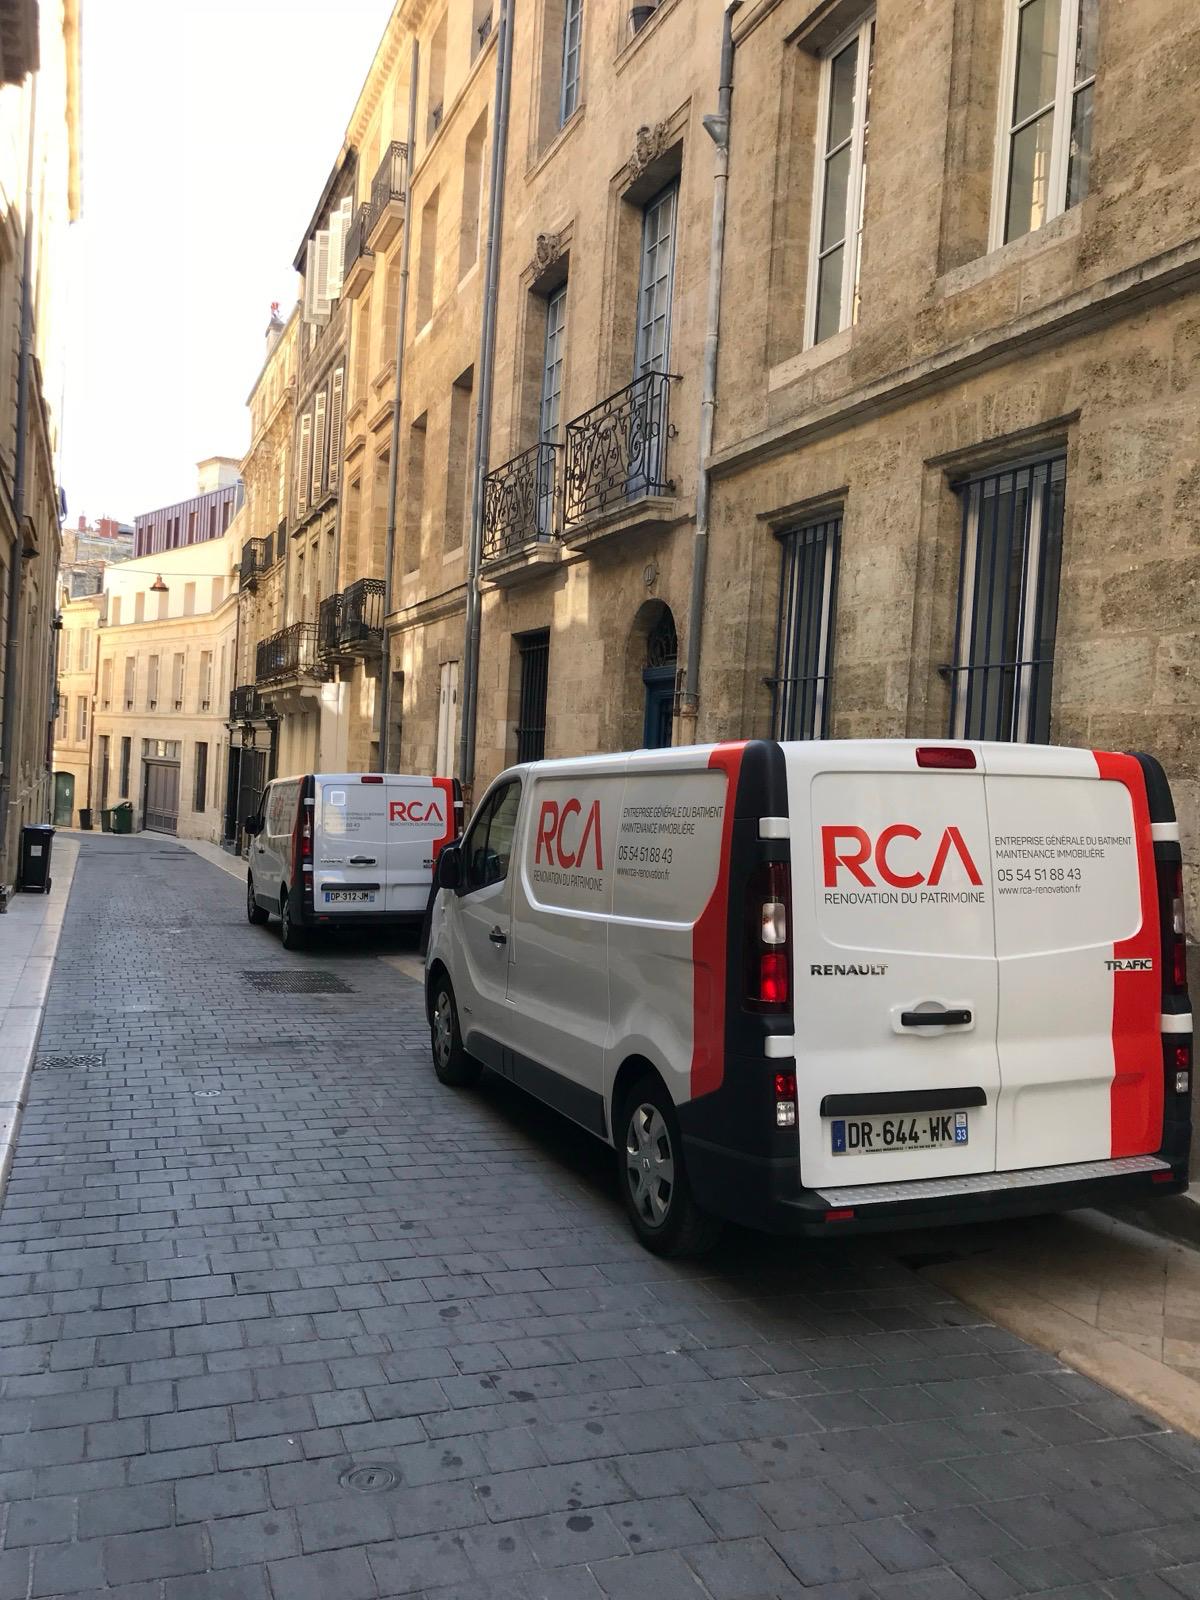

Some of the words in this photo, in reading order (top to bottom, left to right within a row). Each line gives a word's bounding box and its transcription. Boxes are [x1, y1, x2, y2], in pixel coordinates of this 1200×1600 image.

[389, 801, 444, 821] RCA
[682, 806, 691, 818] DU
[535, 798, 603, 870] RCA
[621, 822, 658, 834] MAINTENANCE
[994, 836, 1045, 846] ENTREPRISE
[1086, 836, 1097, 845] DU
[618, 846, 628, 860] 05
[628, 846, 639, 861] 54
[640, 847, 649, 861] 51
[649, 847, 660, 862] 88
[662, 848, 673, 863] 43
[821, 824, 983, 888] RCA
[996, 849, 1055, 859] MAINTENANCE
[998, 869, 1013, 881] 05
[1016, 869, 1031, 881] 54
[1035, 868, 1047, 880] 51
[1050, 868, 1064, 880] 88
[1067, 868, 1081, 880] 43
[998, 884, 1081, 895] www.rca-renovation.fr
[824, 893, 898, 905] RENOVATION
[901, 892, 918, 904] DU
[921, 892, 985, 904] PATRIMOINE
[810, 964, 889, 976] RENAULT
[1104, 959, 1153, 971] TRAFIC
[848, 1116, 953, 1148] DR-644-WK
[956, 1129, 967, 1141] 33
